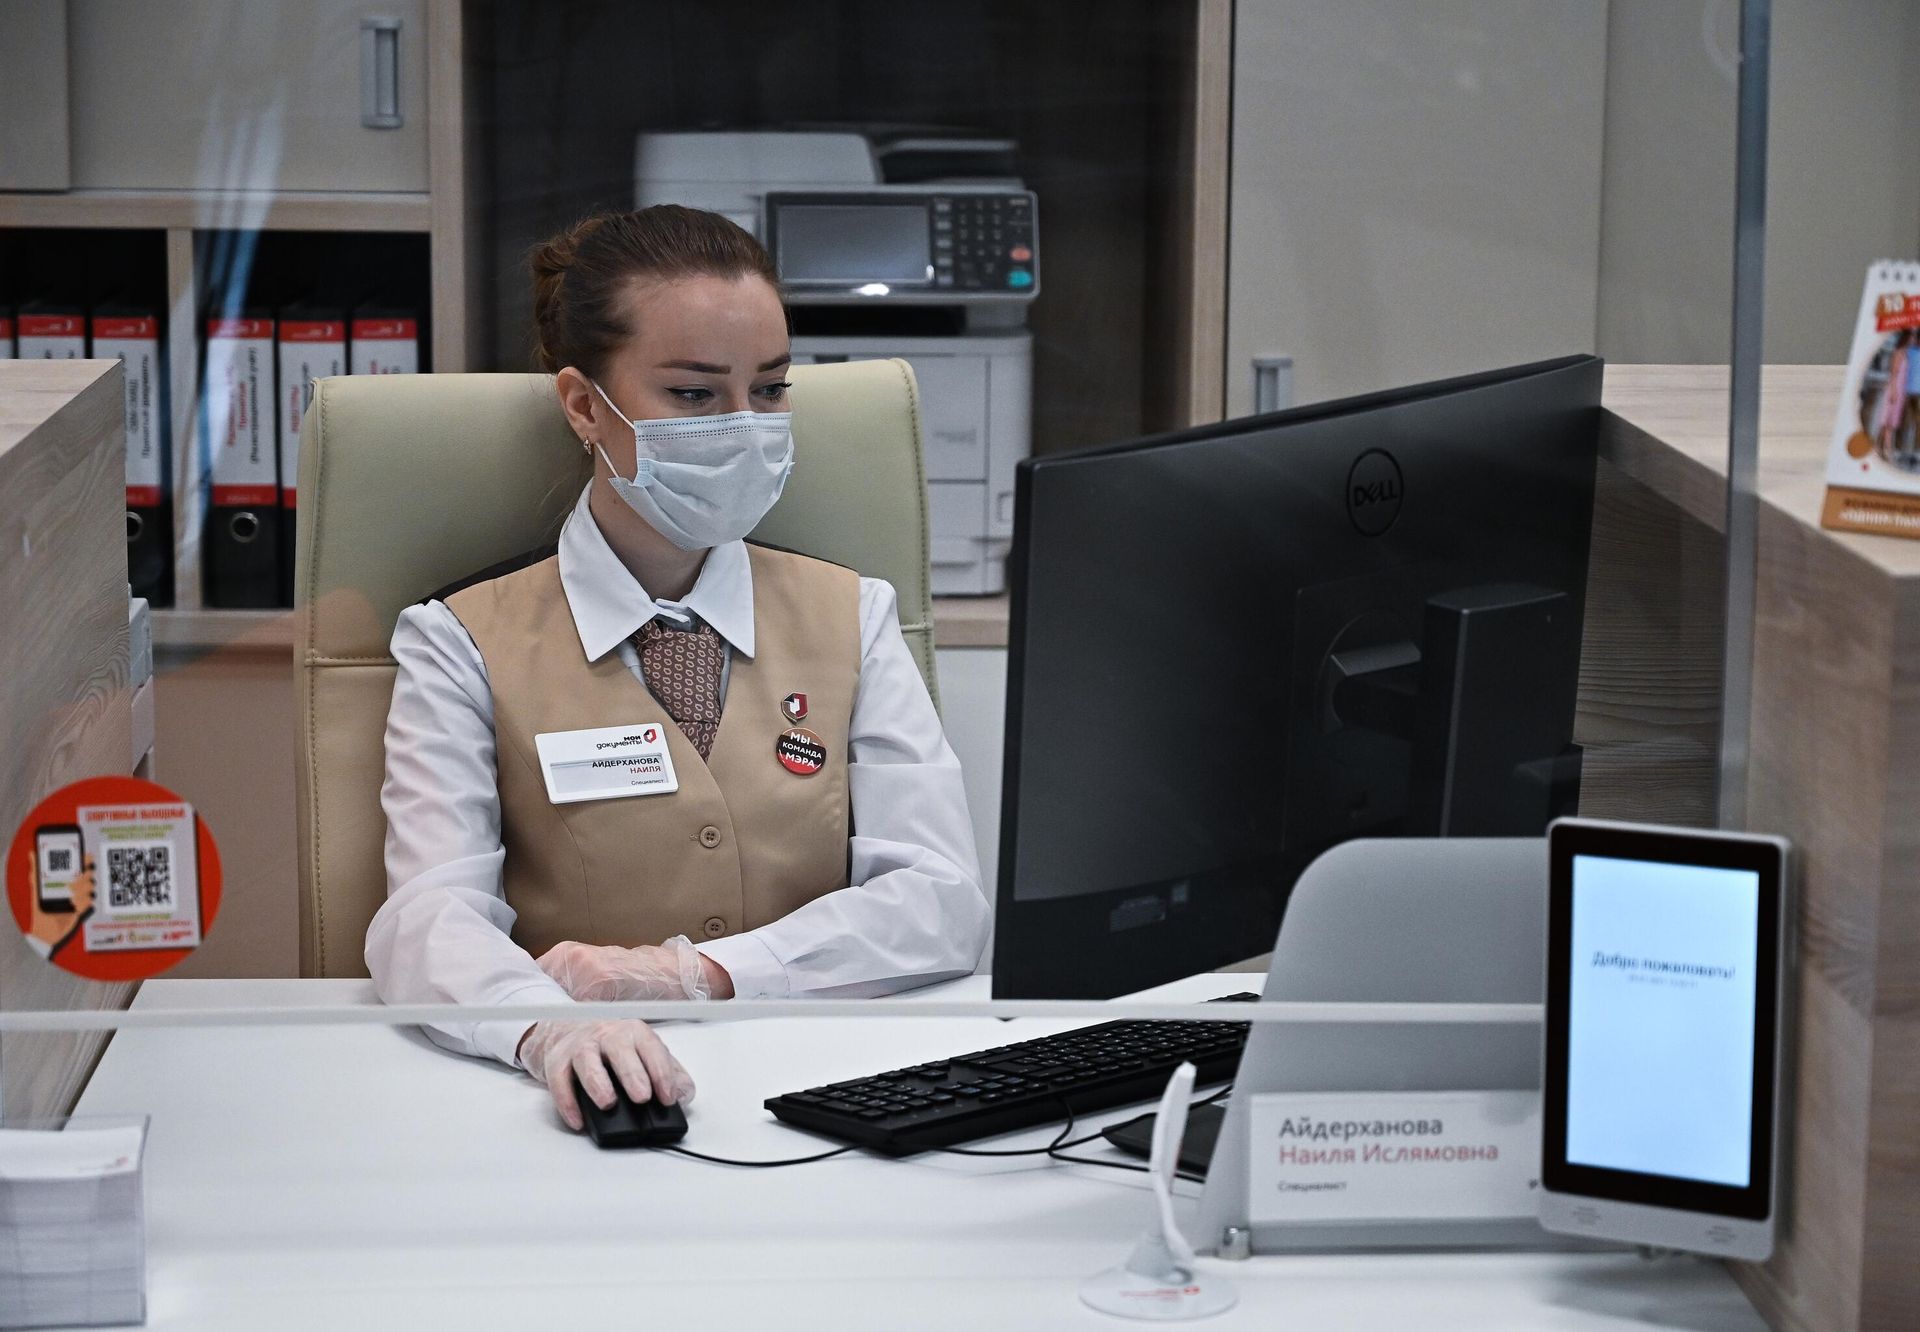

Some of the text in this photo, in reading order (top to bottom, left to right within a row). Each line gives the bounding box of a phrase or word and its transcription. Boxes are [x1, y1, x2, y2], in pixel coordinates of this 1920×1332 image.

[1354, 480, 1398, 507] DELL
[596, 740, 643, 750] документы
[790, 731, 811, 745] МЫ
[782, 742, 822, 759] КОМАНДА
[592, 757, 660, 769] АЙДЕРХАНОВА
[785, 752, 816, 769] МЭРА
[629, 765, 662, 775] НАИЛЯ
[1591, 950, 1638, 970] Добро
[1278, 1117, 1444, 1141] Айдерханова
[1279, 1143, 1499, 1165] Наиля Ислямовна
